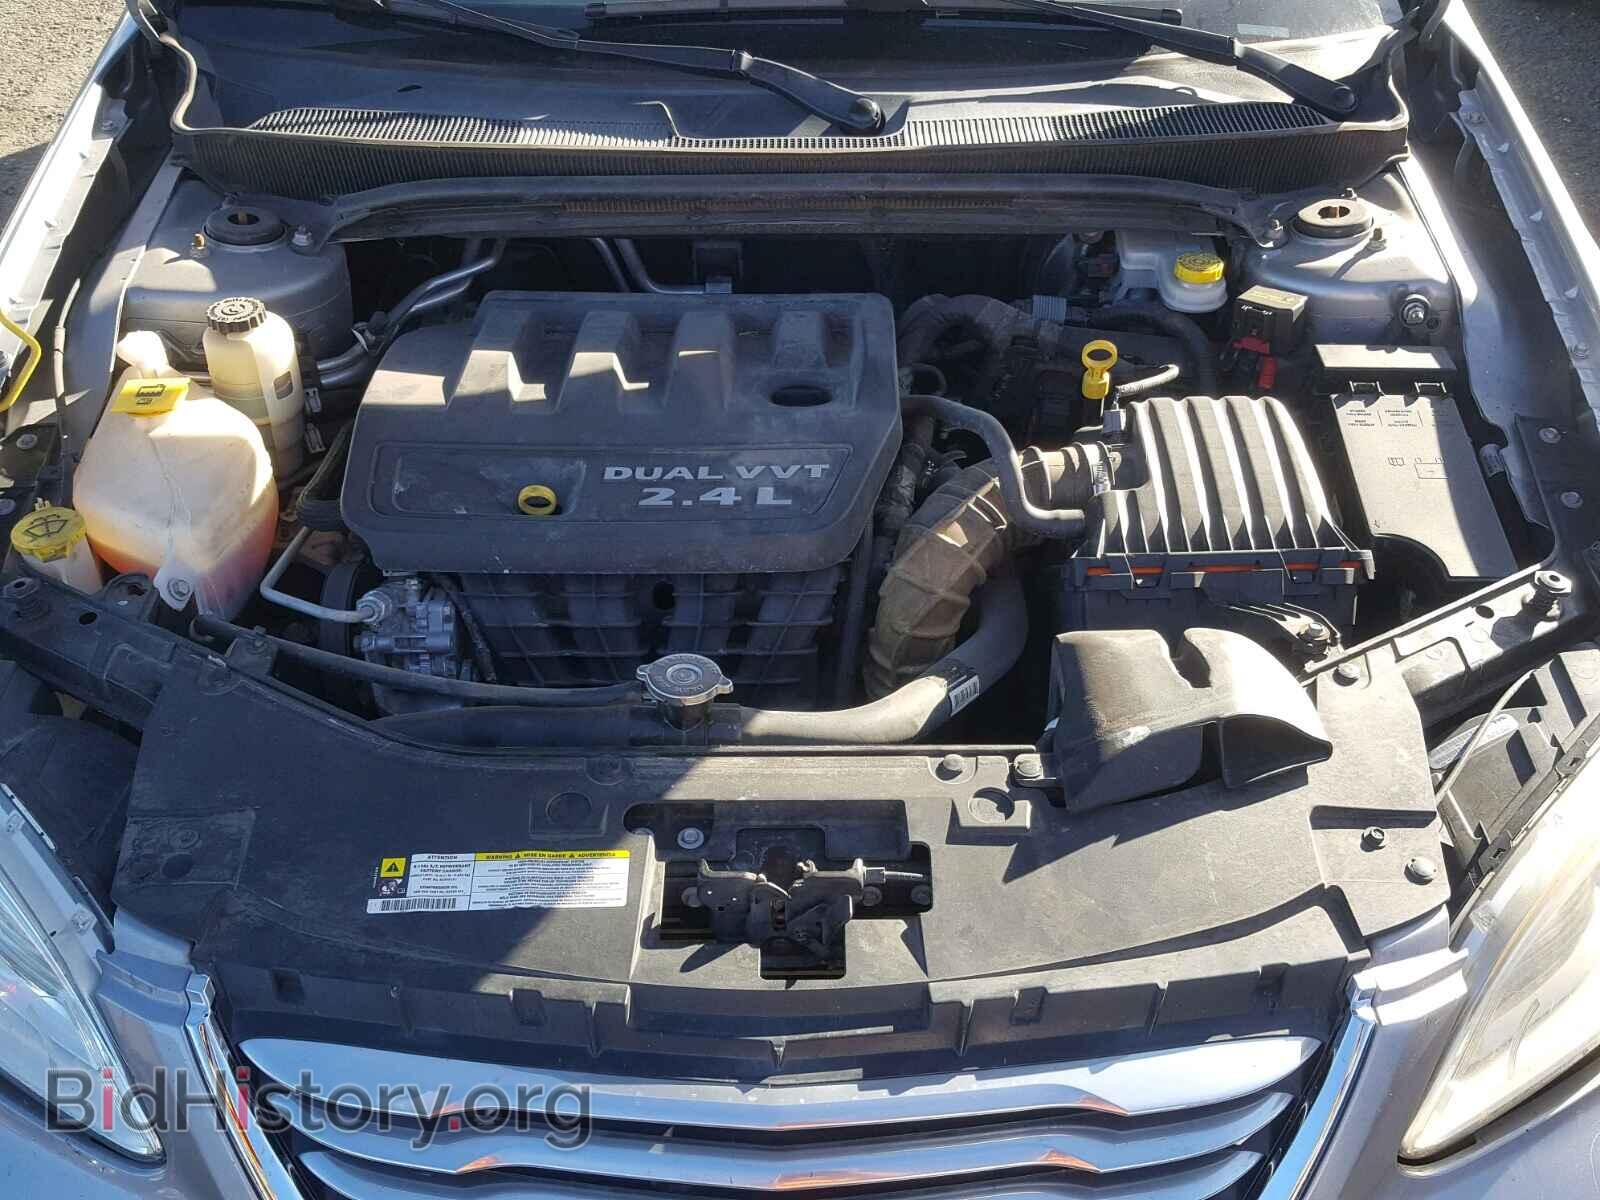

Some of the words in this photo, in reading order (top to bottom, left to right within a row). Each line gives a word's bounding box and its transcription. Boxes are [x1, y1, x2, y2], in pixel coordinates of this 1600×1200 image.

[603, 466, 724, 480] DUAL
[736, 464, 830, 479] VVT
[638, 487, 742, 506] 2.4
